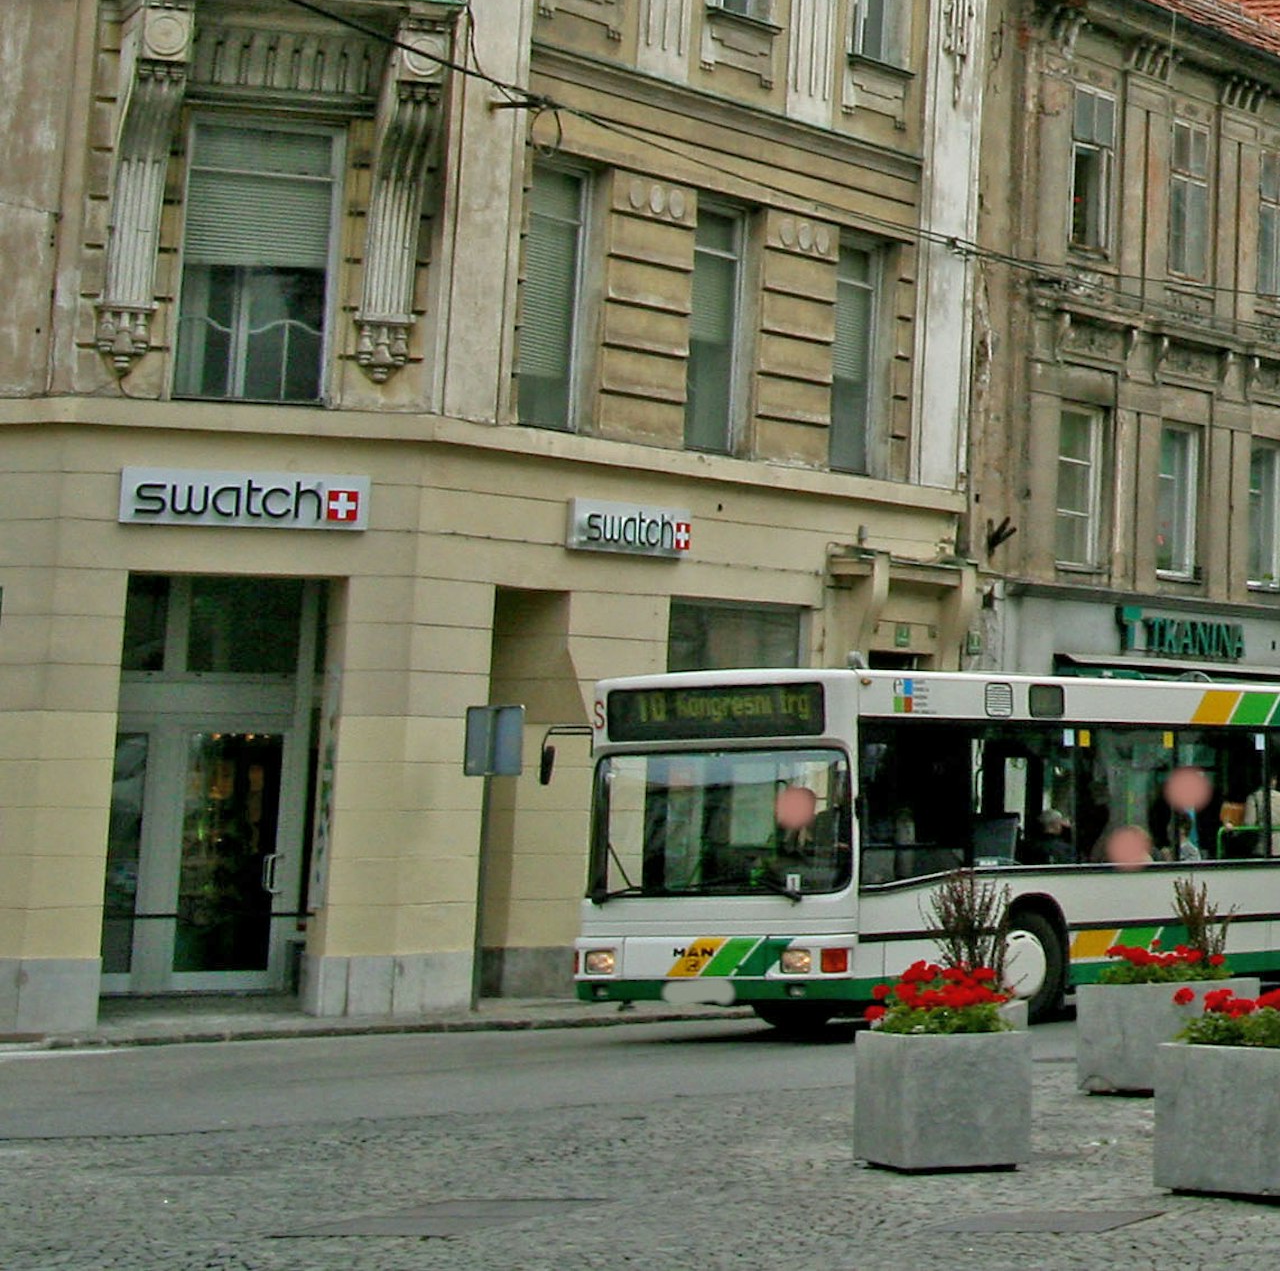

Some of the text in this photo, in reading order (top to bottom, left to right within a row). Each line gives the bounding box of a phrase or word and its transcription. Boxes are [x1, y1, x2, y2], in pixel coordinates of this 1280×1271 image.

[134, 479, 322, 521] swatch
[587, 511, 674, 548] swatch
[1146, 616, 1245, 661] TKANINA
[673, 947, 714, 957] MAN
